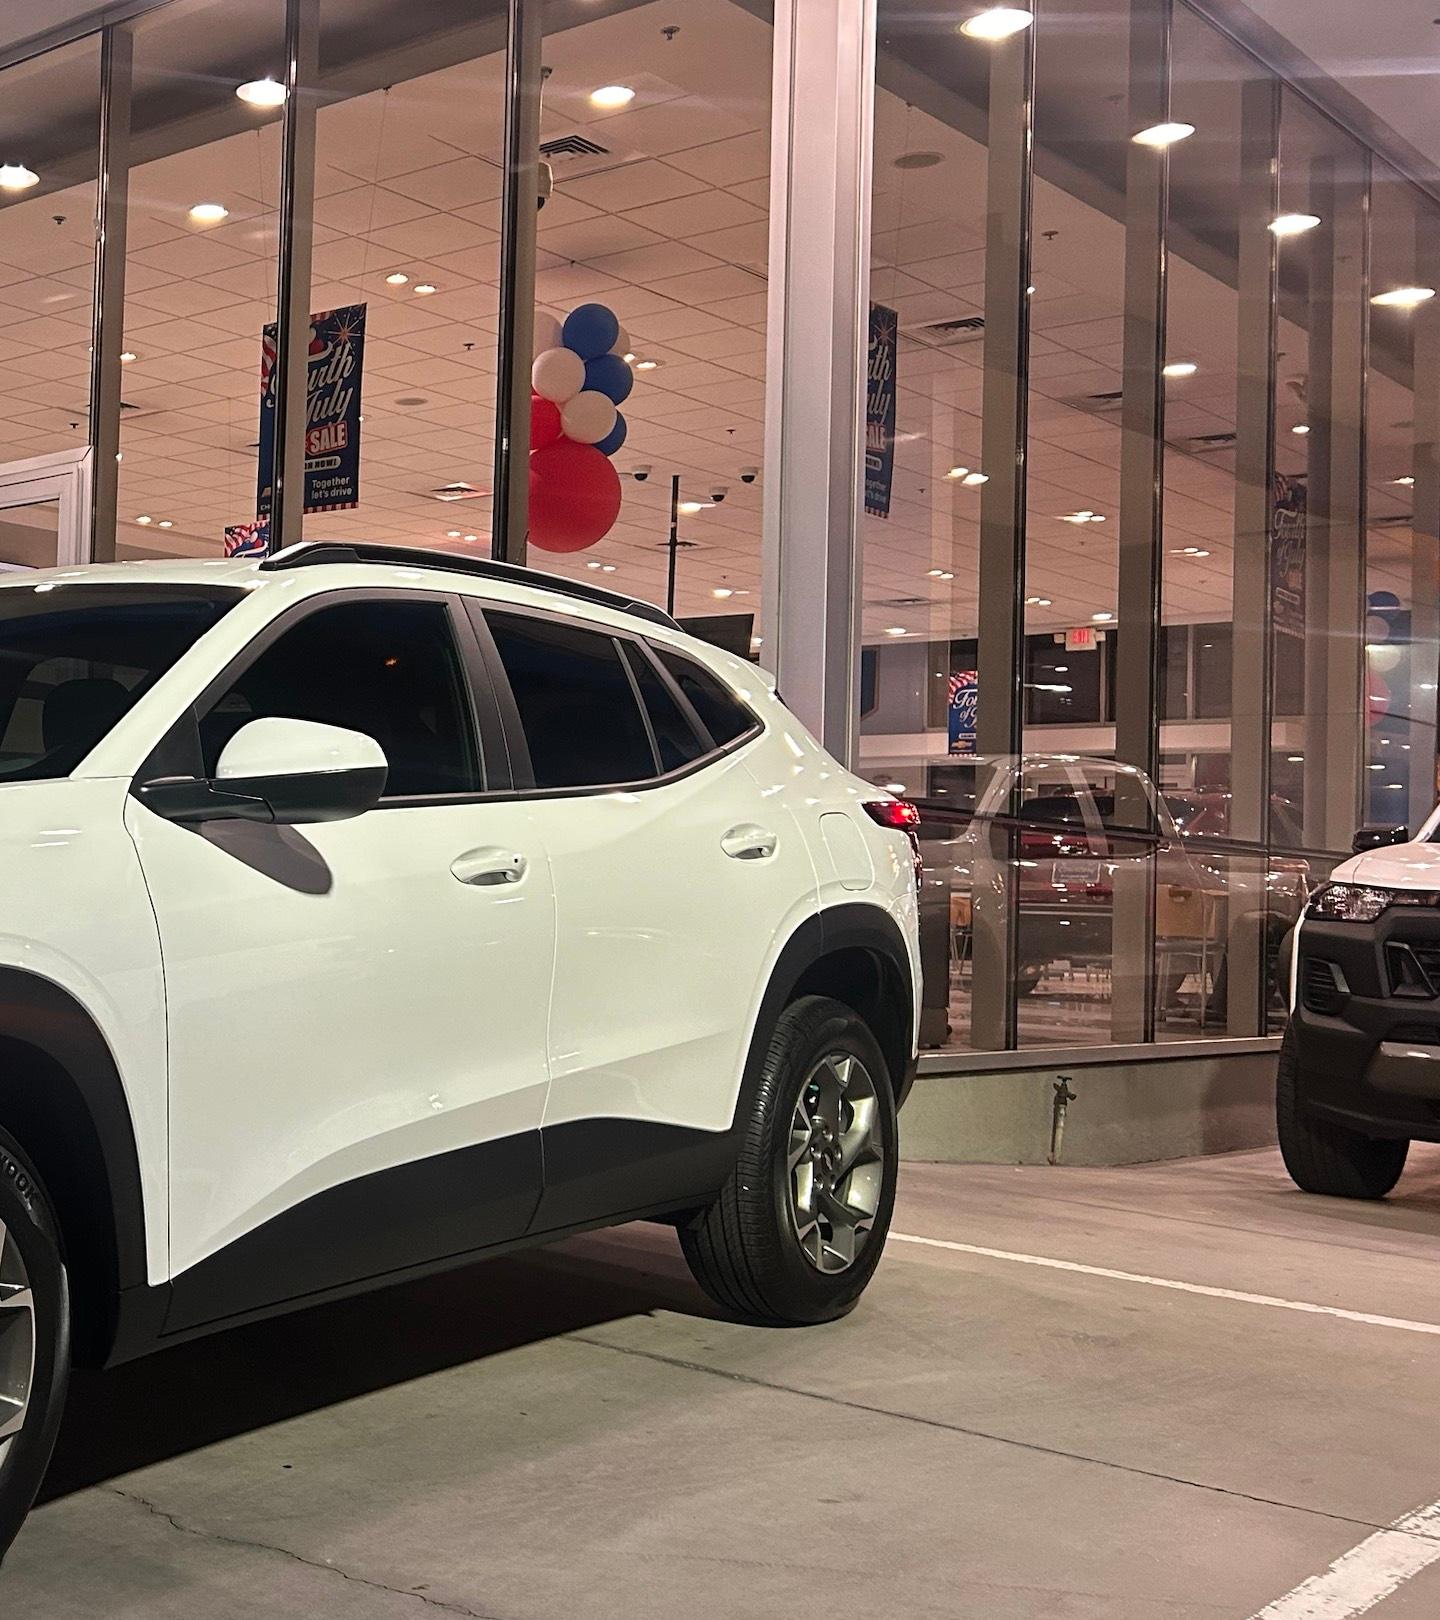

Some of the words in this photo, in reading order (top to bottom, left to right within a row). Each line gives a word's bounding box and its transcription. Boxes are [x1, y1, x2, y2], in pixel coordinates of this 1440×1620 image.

[309, 423, 346, 453] SALE
[312, 476, 350, 490] Together
[311, 489, 329, 500] let's
[330, 486, 353, 498] drive
